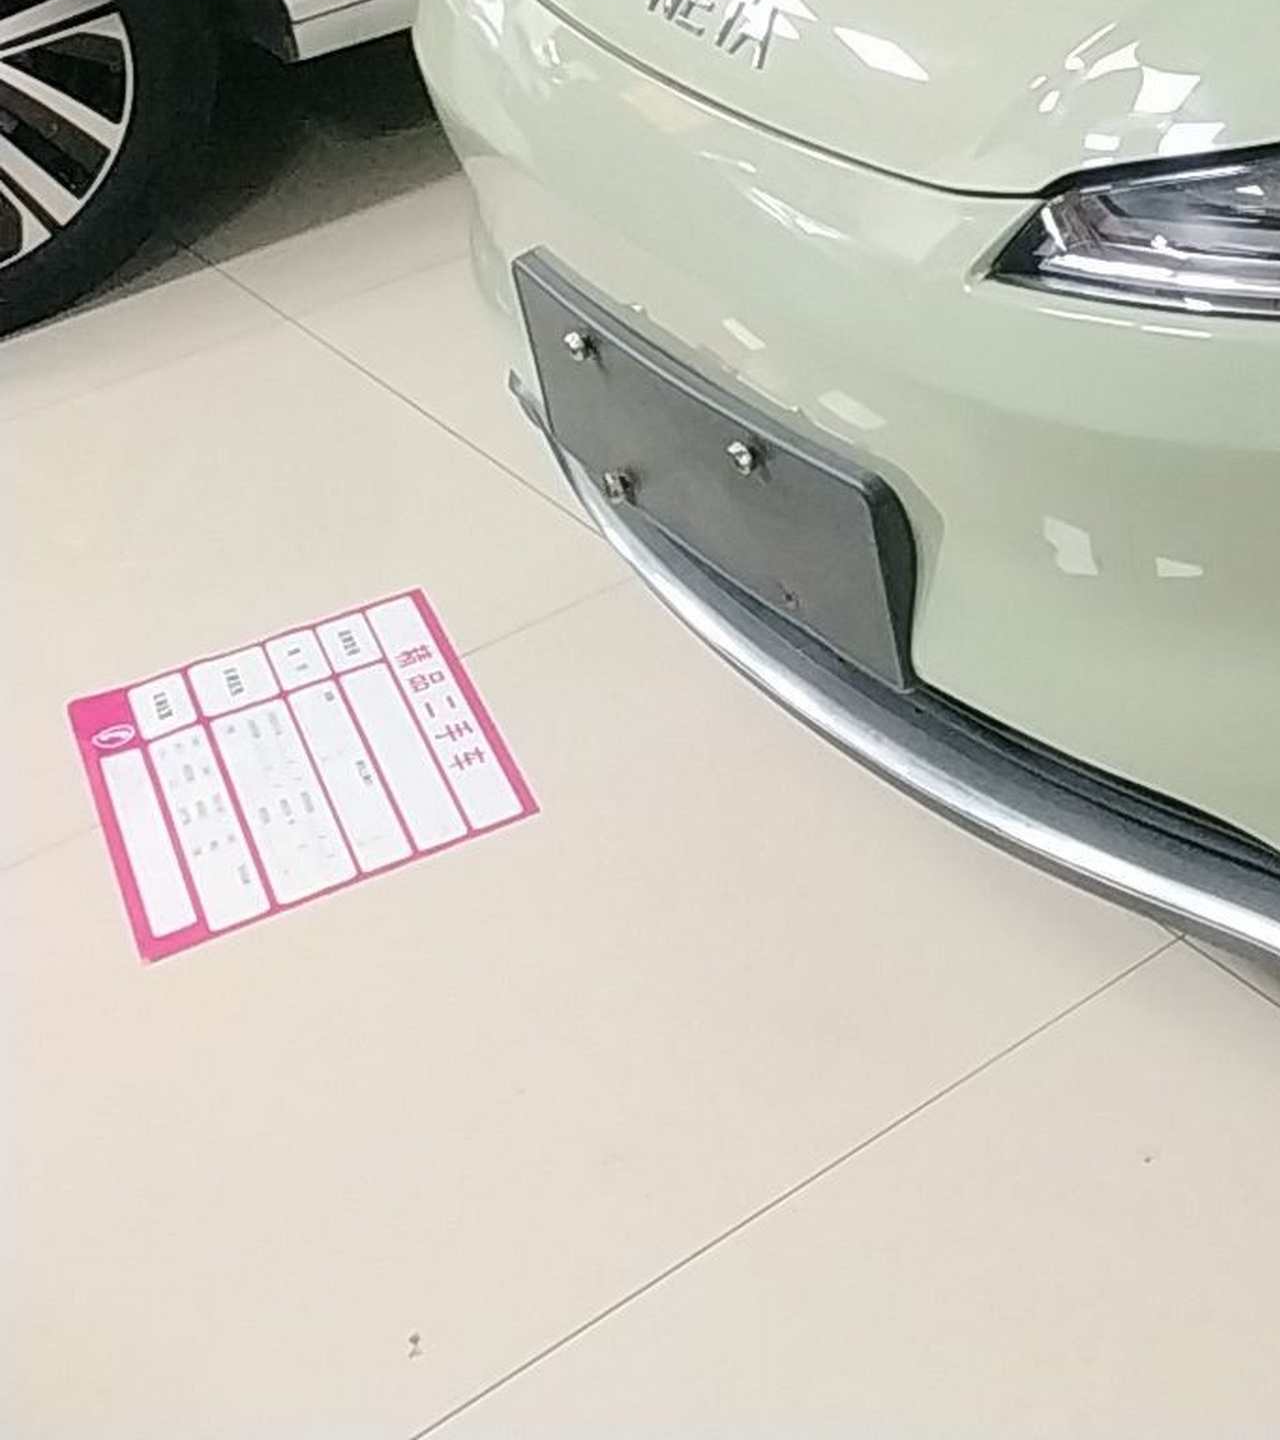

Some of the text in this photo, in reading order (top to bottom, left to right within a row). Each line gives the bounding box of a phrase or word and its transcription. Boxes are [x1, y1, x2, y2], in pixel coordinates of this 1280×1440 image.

[396, 644, 487, 770] 精品二手车
